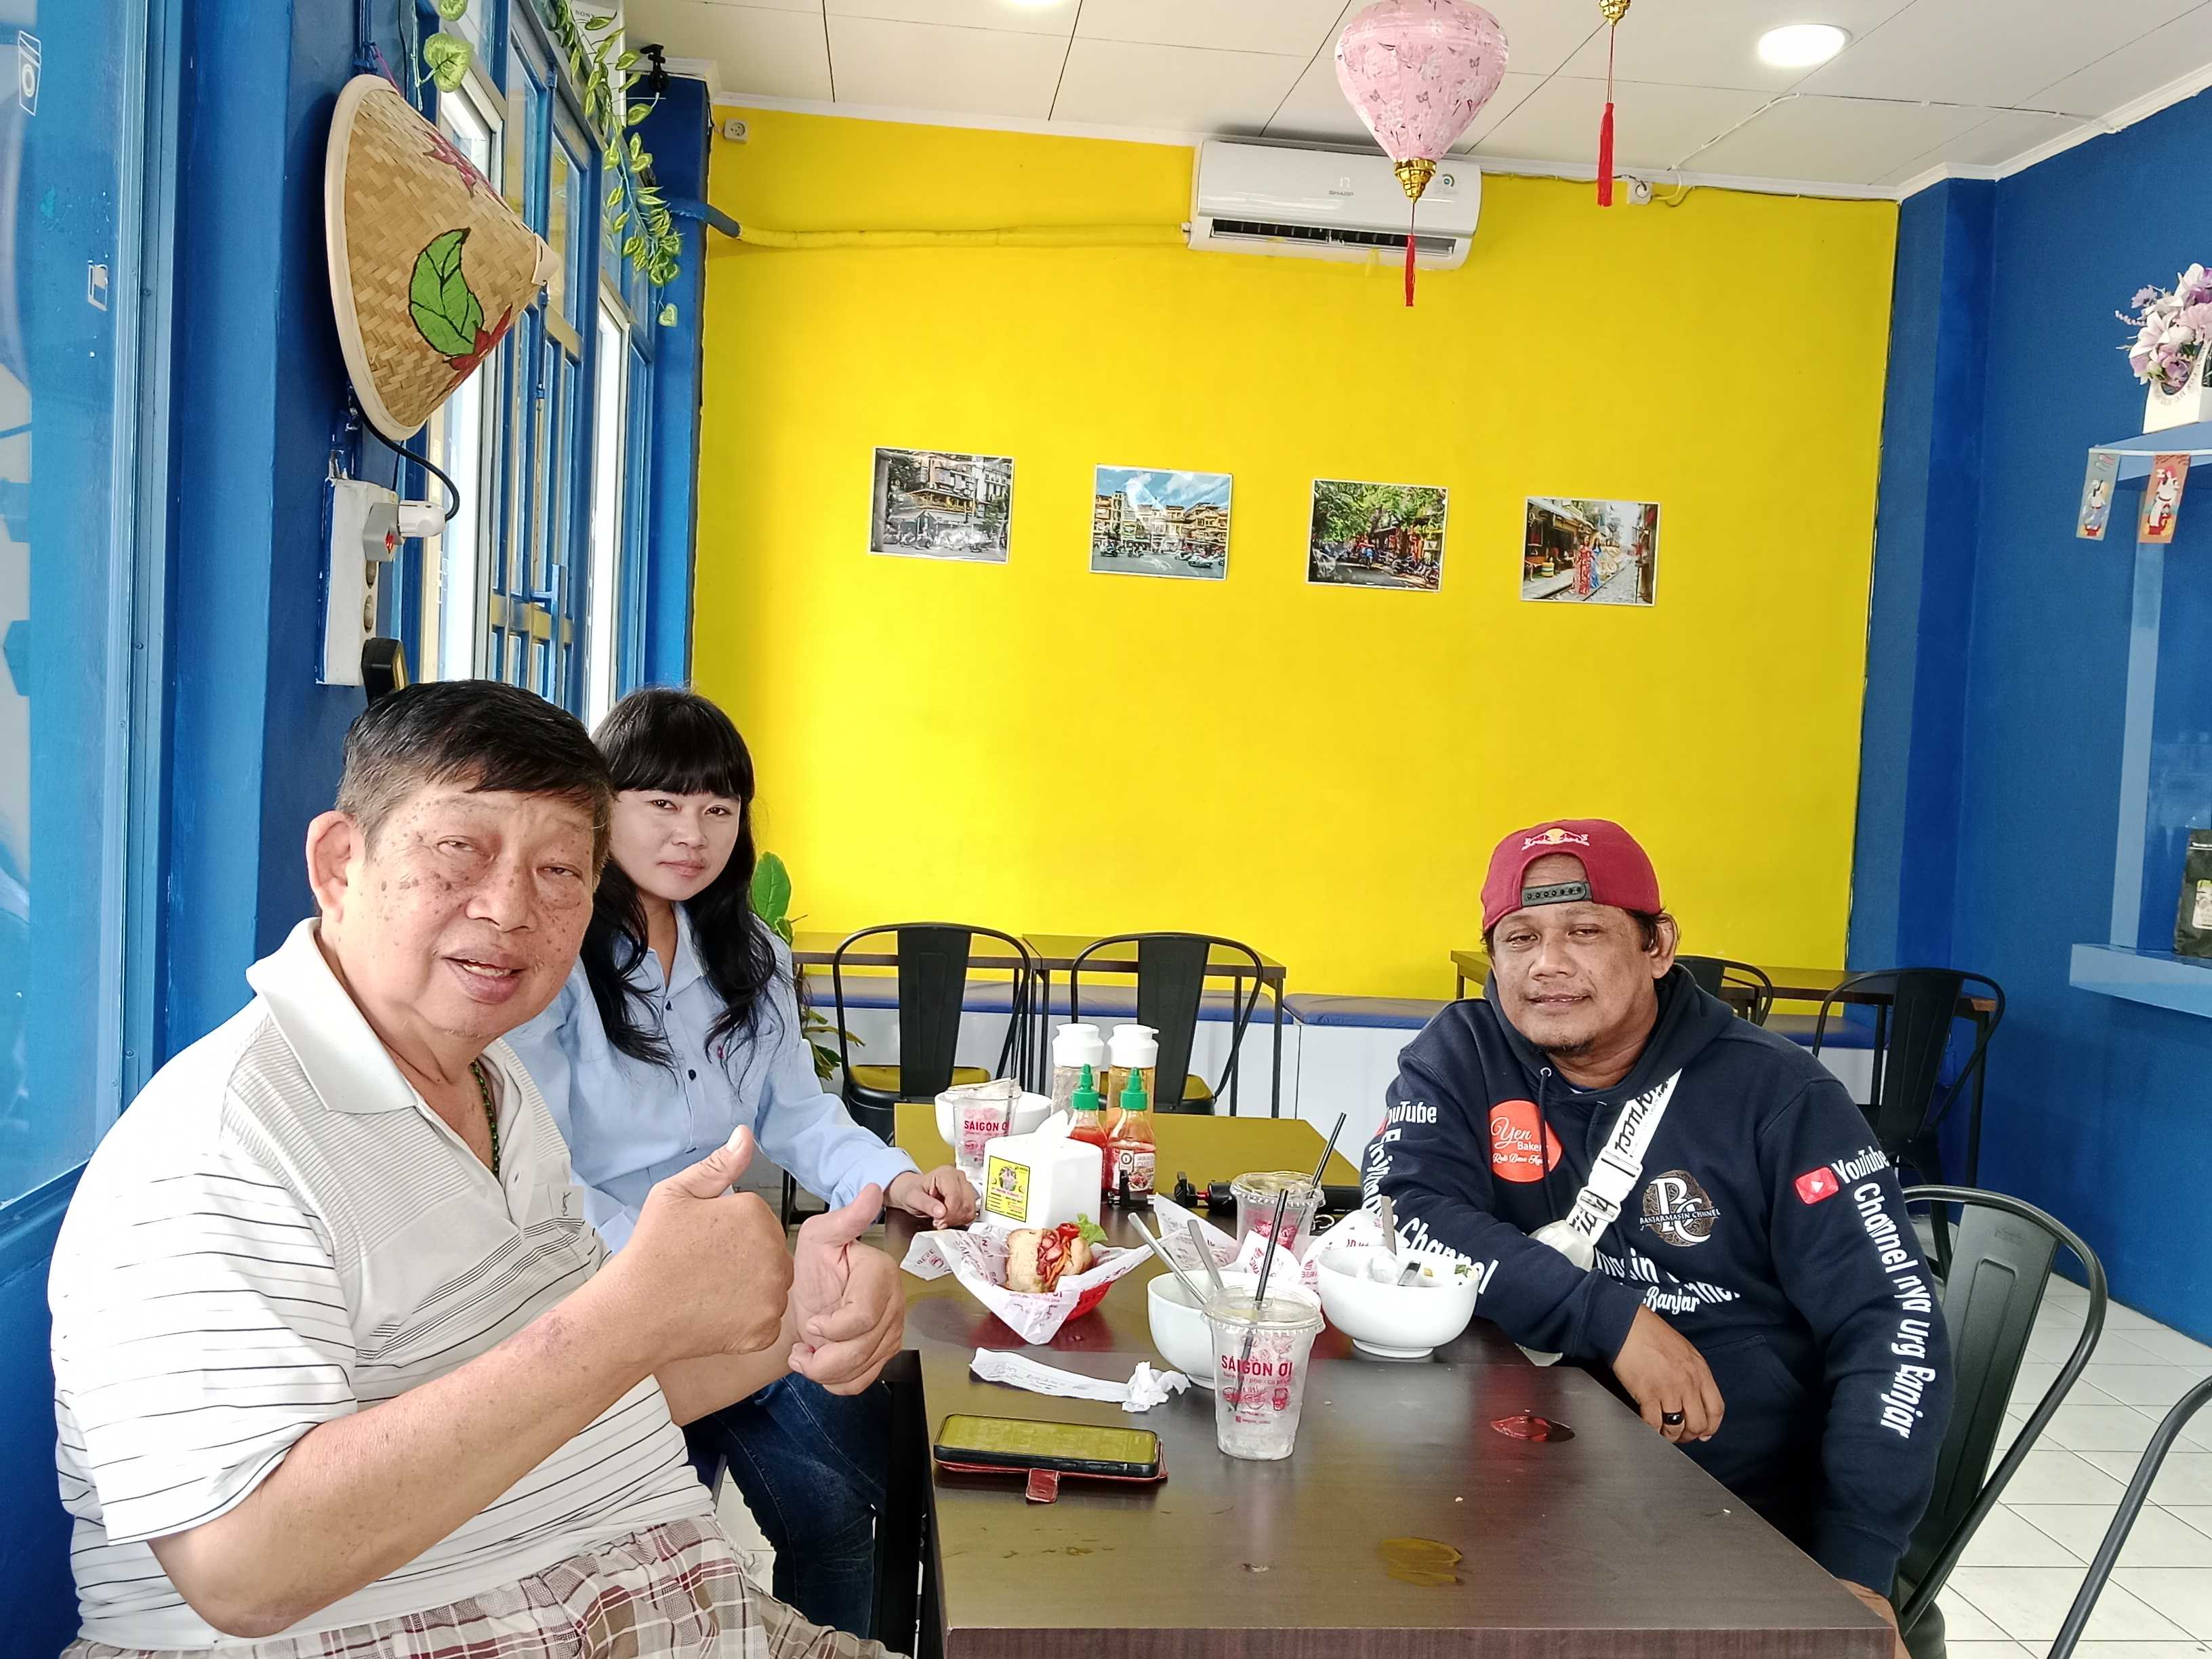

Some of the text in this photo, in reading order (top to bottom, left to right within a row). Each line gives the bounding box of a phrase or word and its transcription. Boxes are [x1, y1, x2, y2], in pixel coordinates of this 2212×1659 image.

[1491, 1116, 1532, 1149] Yen
[1831, 1146, 1890, 1184] YouTube
[1853, 1183, 1919, 1273] Channel
[1645, 1286, 1700, 1315] Banjar
[1893, 1275, 1931, 1313] nya
[1880, 1364, 1936, 1439] Banjar
